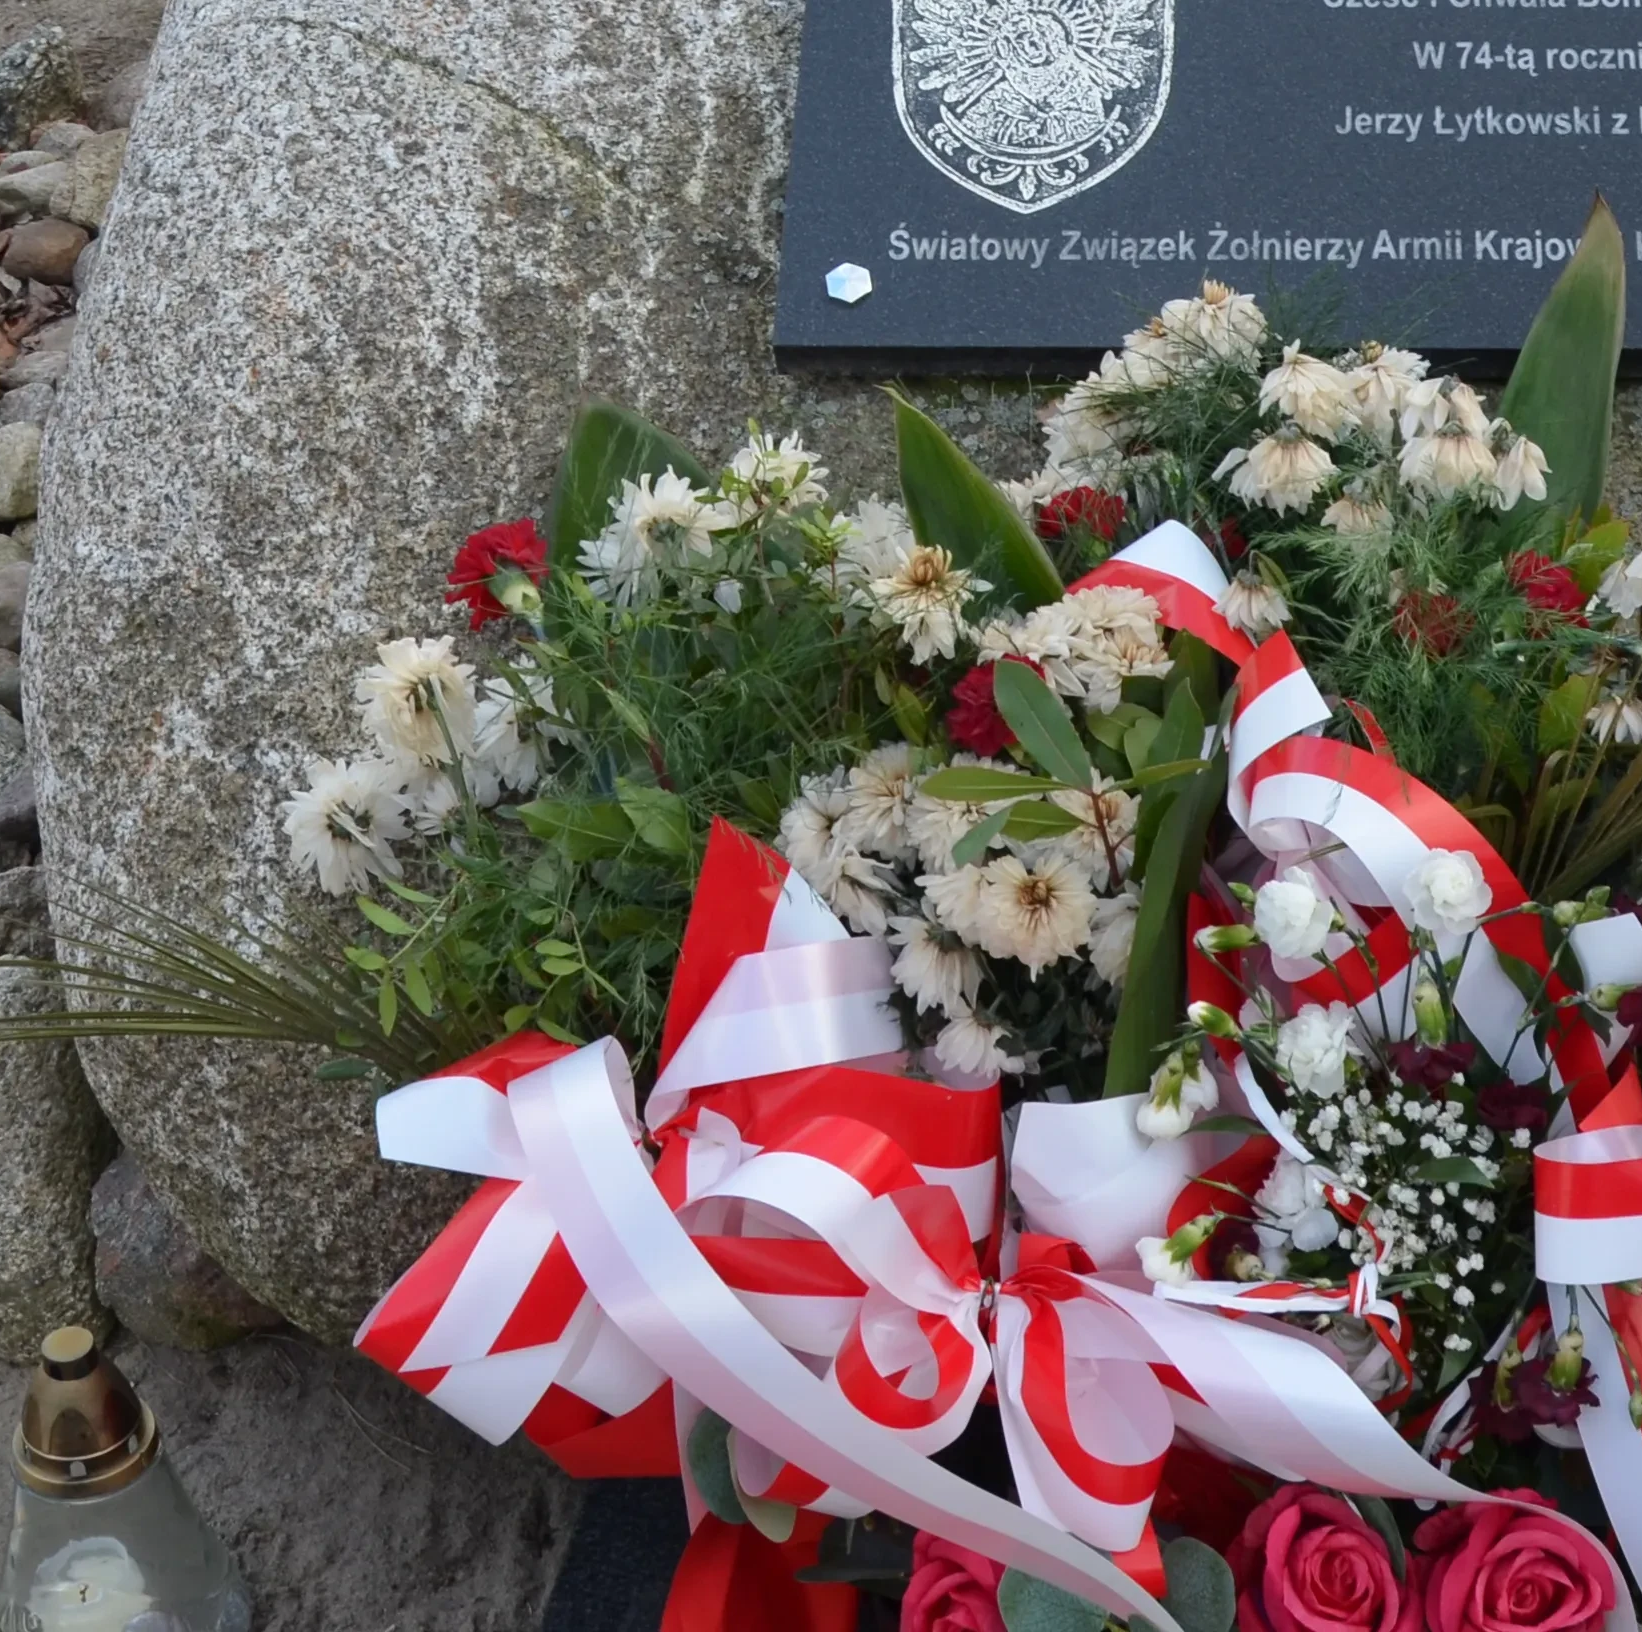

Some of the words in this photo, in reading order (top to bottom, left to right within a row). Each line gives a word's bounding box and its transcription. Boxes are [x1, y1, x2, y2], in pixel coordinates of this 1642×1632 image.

[1412, 40, 1446, 70] W
[1455, 40, 1539, 78] 74-tą
[1334, 105, 1424, 143] Jerzy
[1432, 105, 1601, 143] Łytkowski
[1610, 112, 1630, 135] z
[887, 221, 1051, 269] Światowy
[1058, 229, 1197, 269] Związek
[1206, 221, 1365, 270] Żołnierzy
[1371, 228, 1463, 261] Armii
[1474, 229, 1585, 270] Krajo
